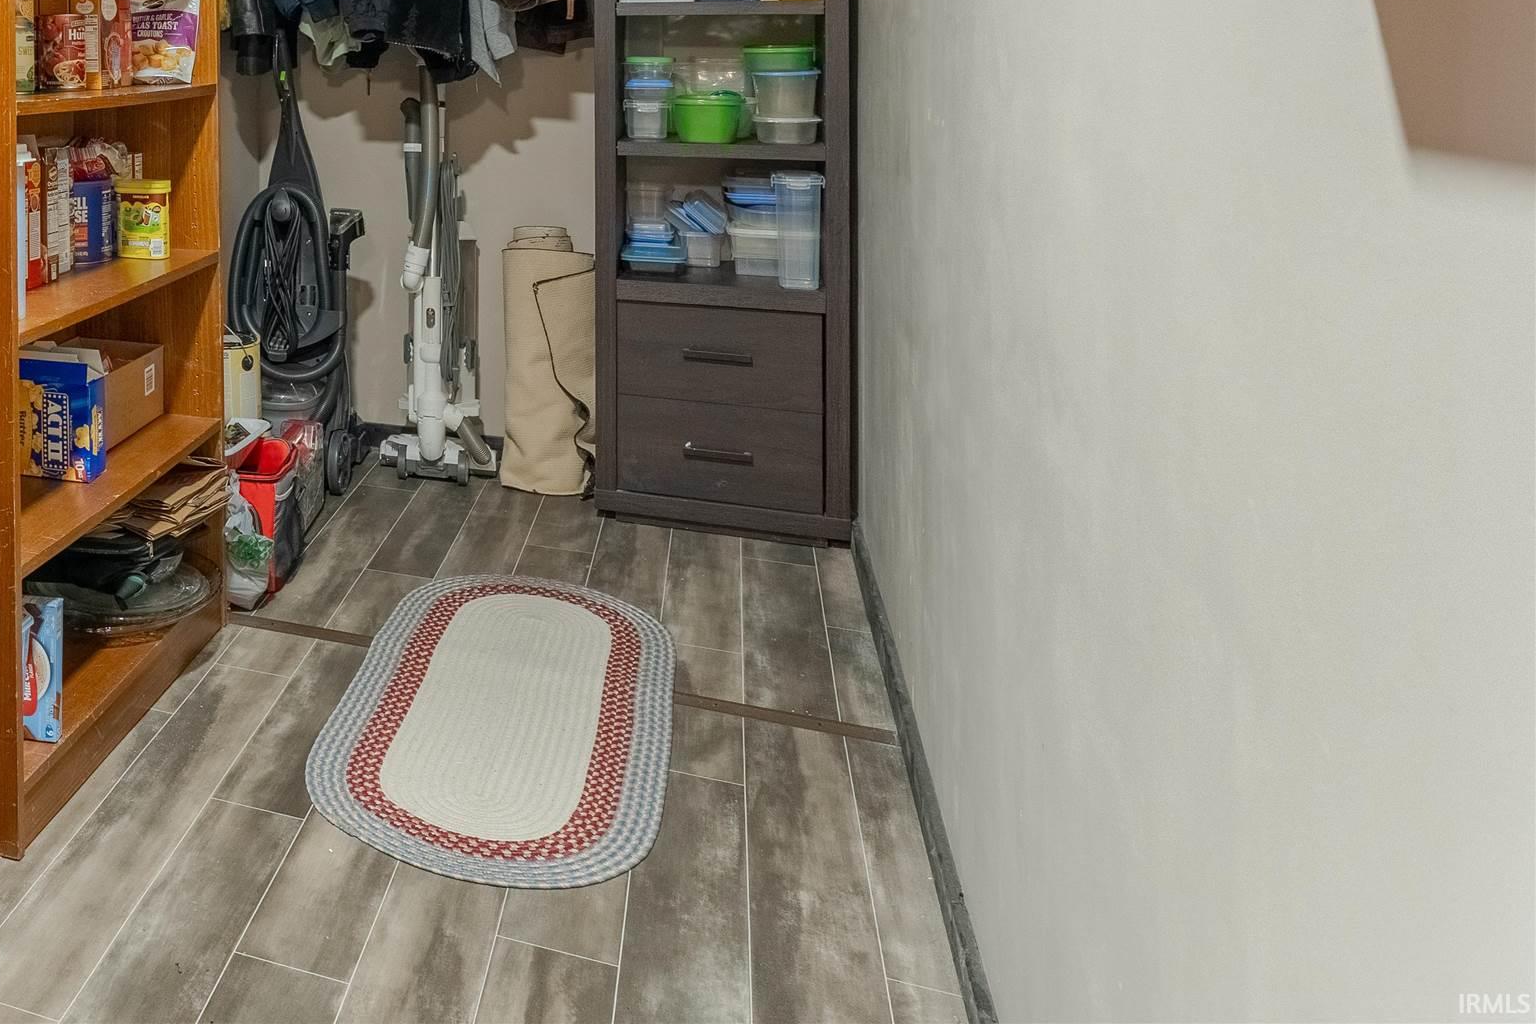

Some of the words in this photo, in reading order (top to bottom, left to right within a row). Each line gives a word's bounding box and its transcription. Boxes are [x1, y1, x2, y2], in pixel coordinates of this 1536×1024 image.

[136, 29, 164, 38] CROUTONS
[152, 20, 179, 31] TOAST
[46, 399, 63, 439] ACT
[47, 439, 63, 463] II
